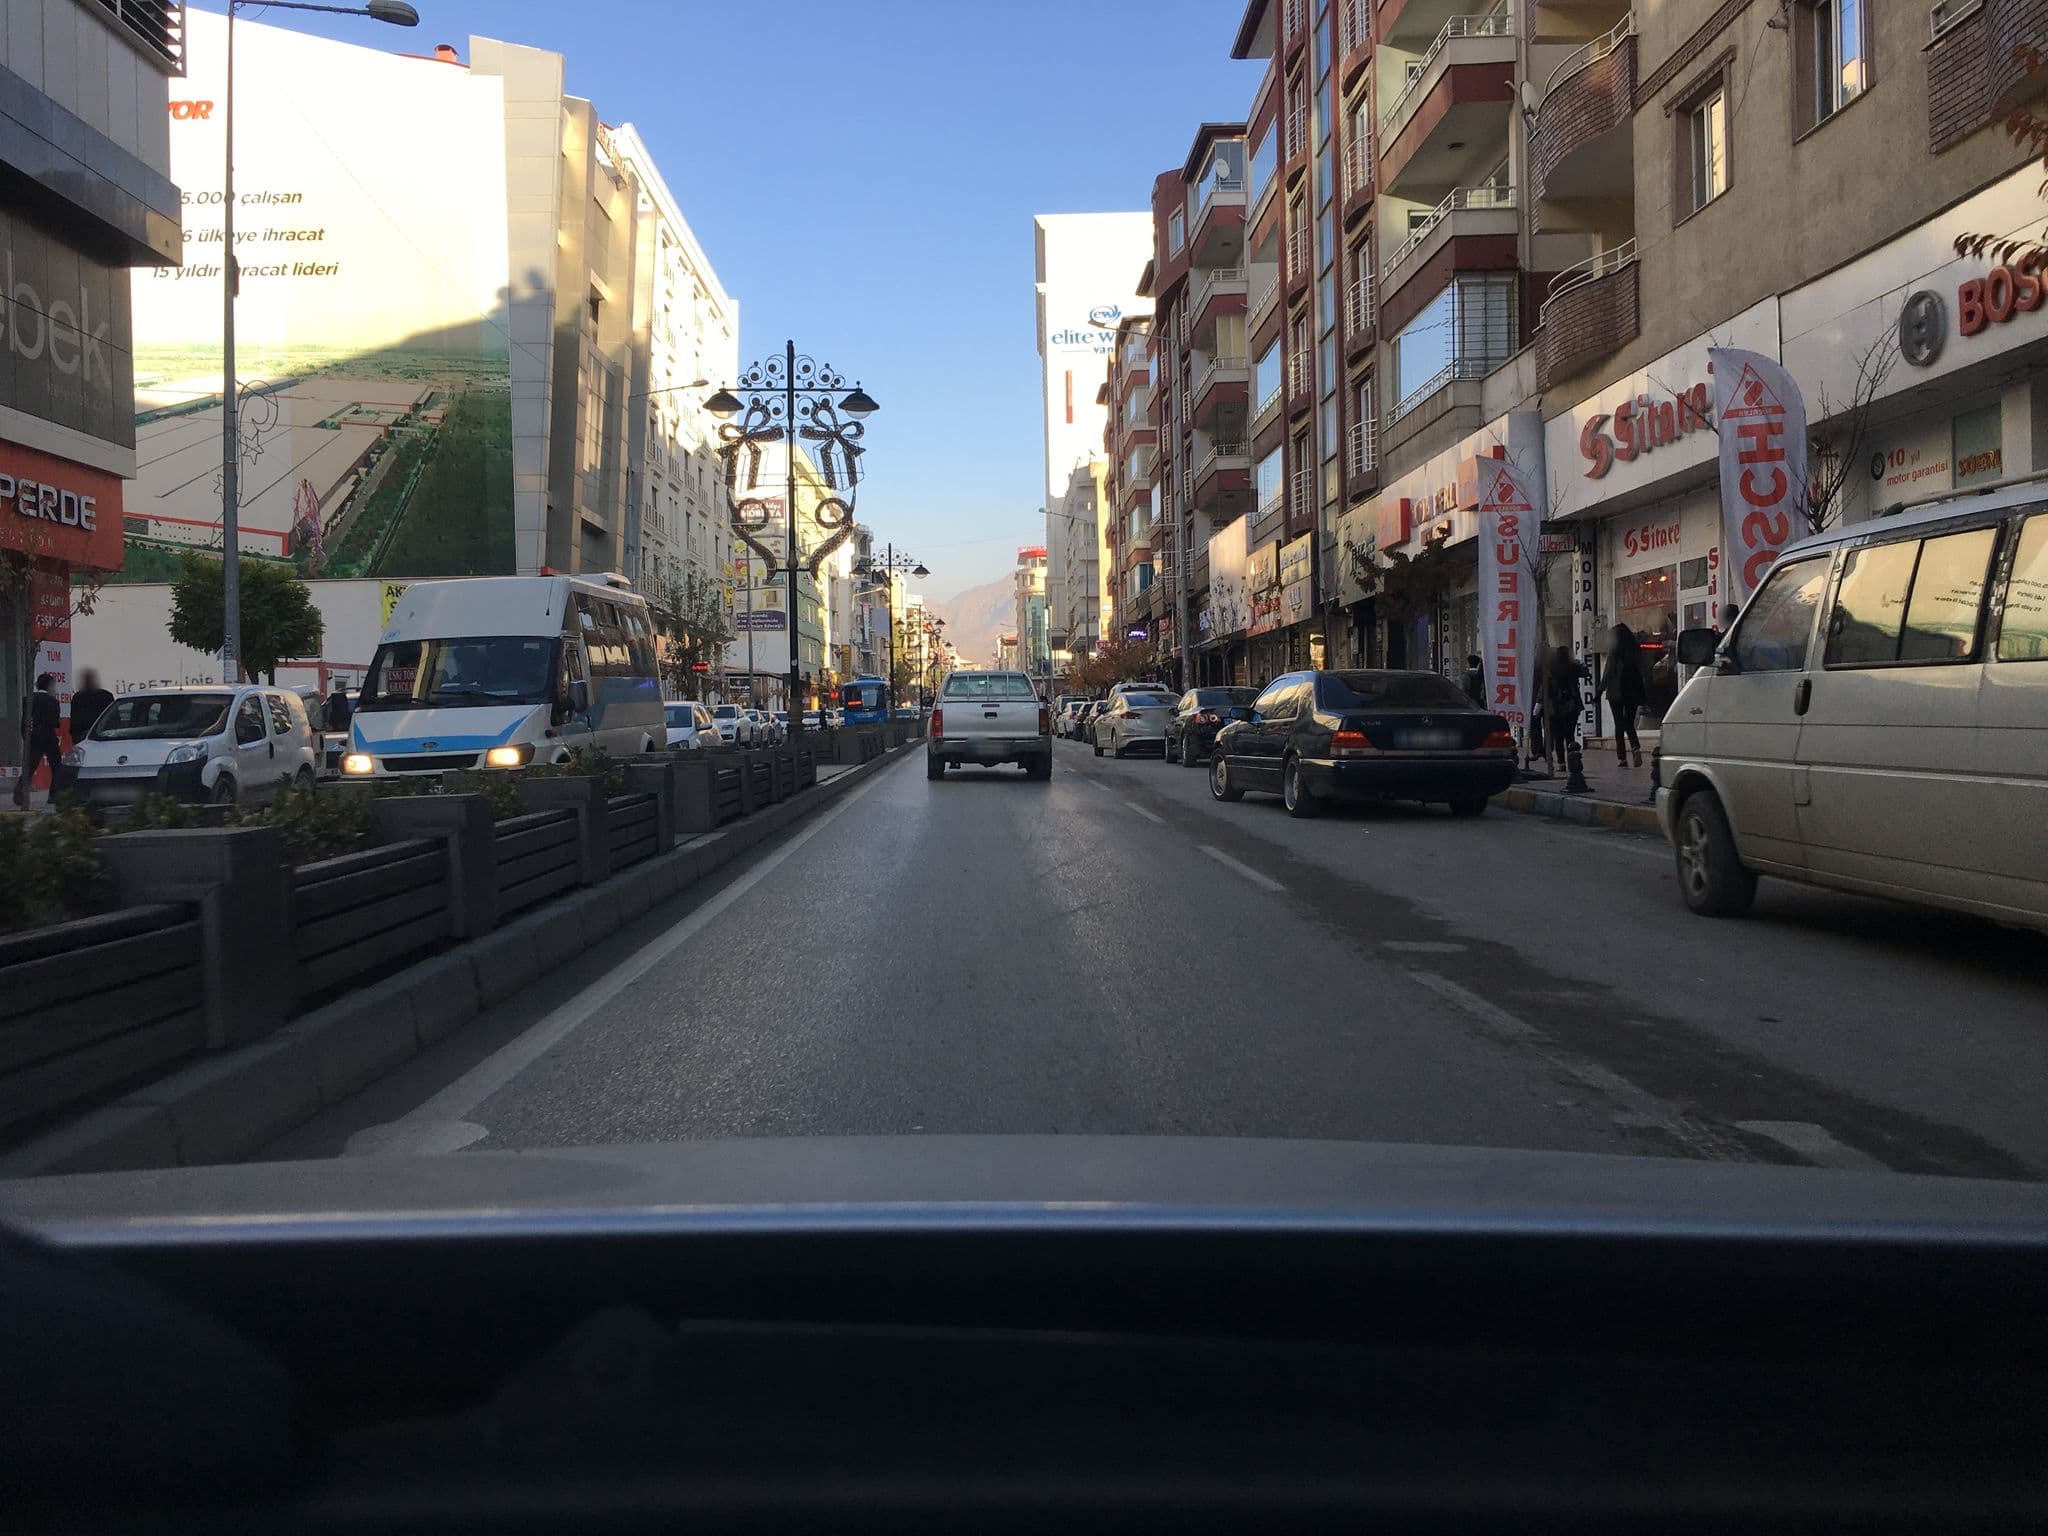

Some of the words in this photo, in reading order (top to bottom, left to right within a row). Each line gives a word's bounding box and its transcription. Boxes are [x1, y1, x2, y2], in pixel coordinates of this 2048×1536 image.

[240, 190, 303, 206] çalışan
[197, 227, 258, 245] ülkye
[262, 226, 326, 242] ihracat
[175, 263, 222, 281] yıldır
[292, 261, 340, 277] lideri
[1959, 250, 2048, 336] BOS
[1051, 329, 1095, 345] elite
[1887, 448, 1905, 469] 10
[1886, 471, 1911, 487] motor
[1911, 461, 1949, 482] garantisi
[1639, 523, 1681, 553] Sitare
[1581, 541, 1593, 613] MODA
